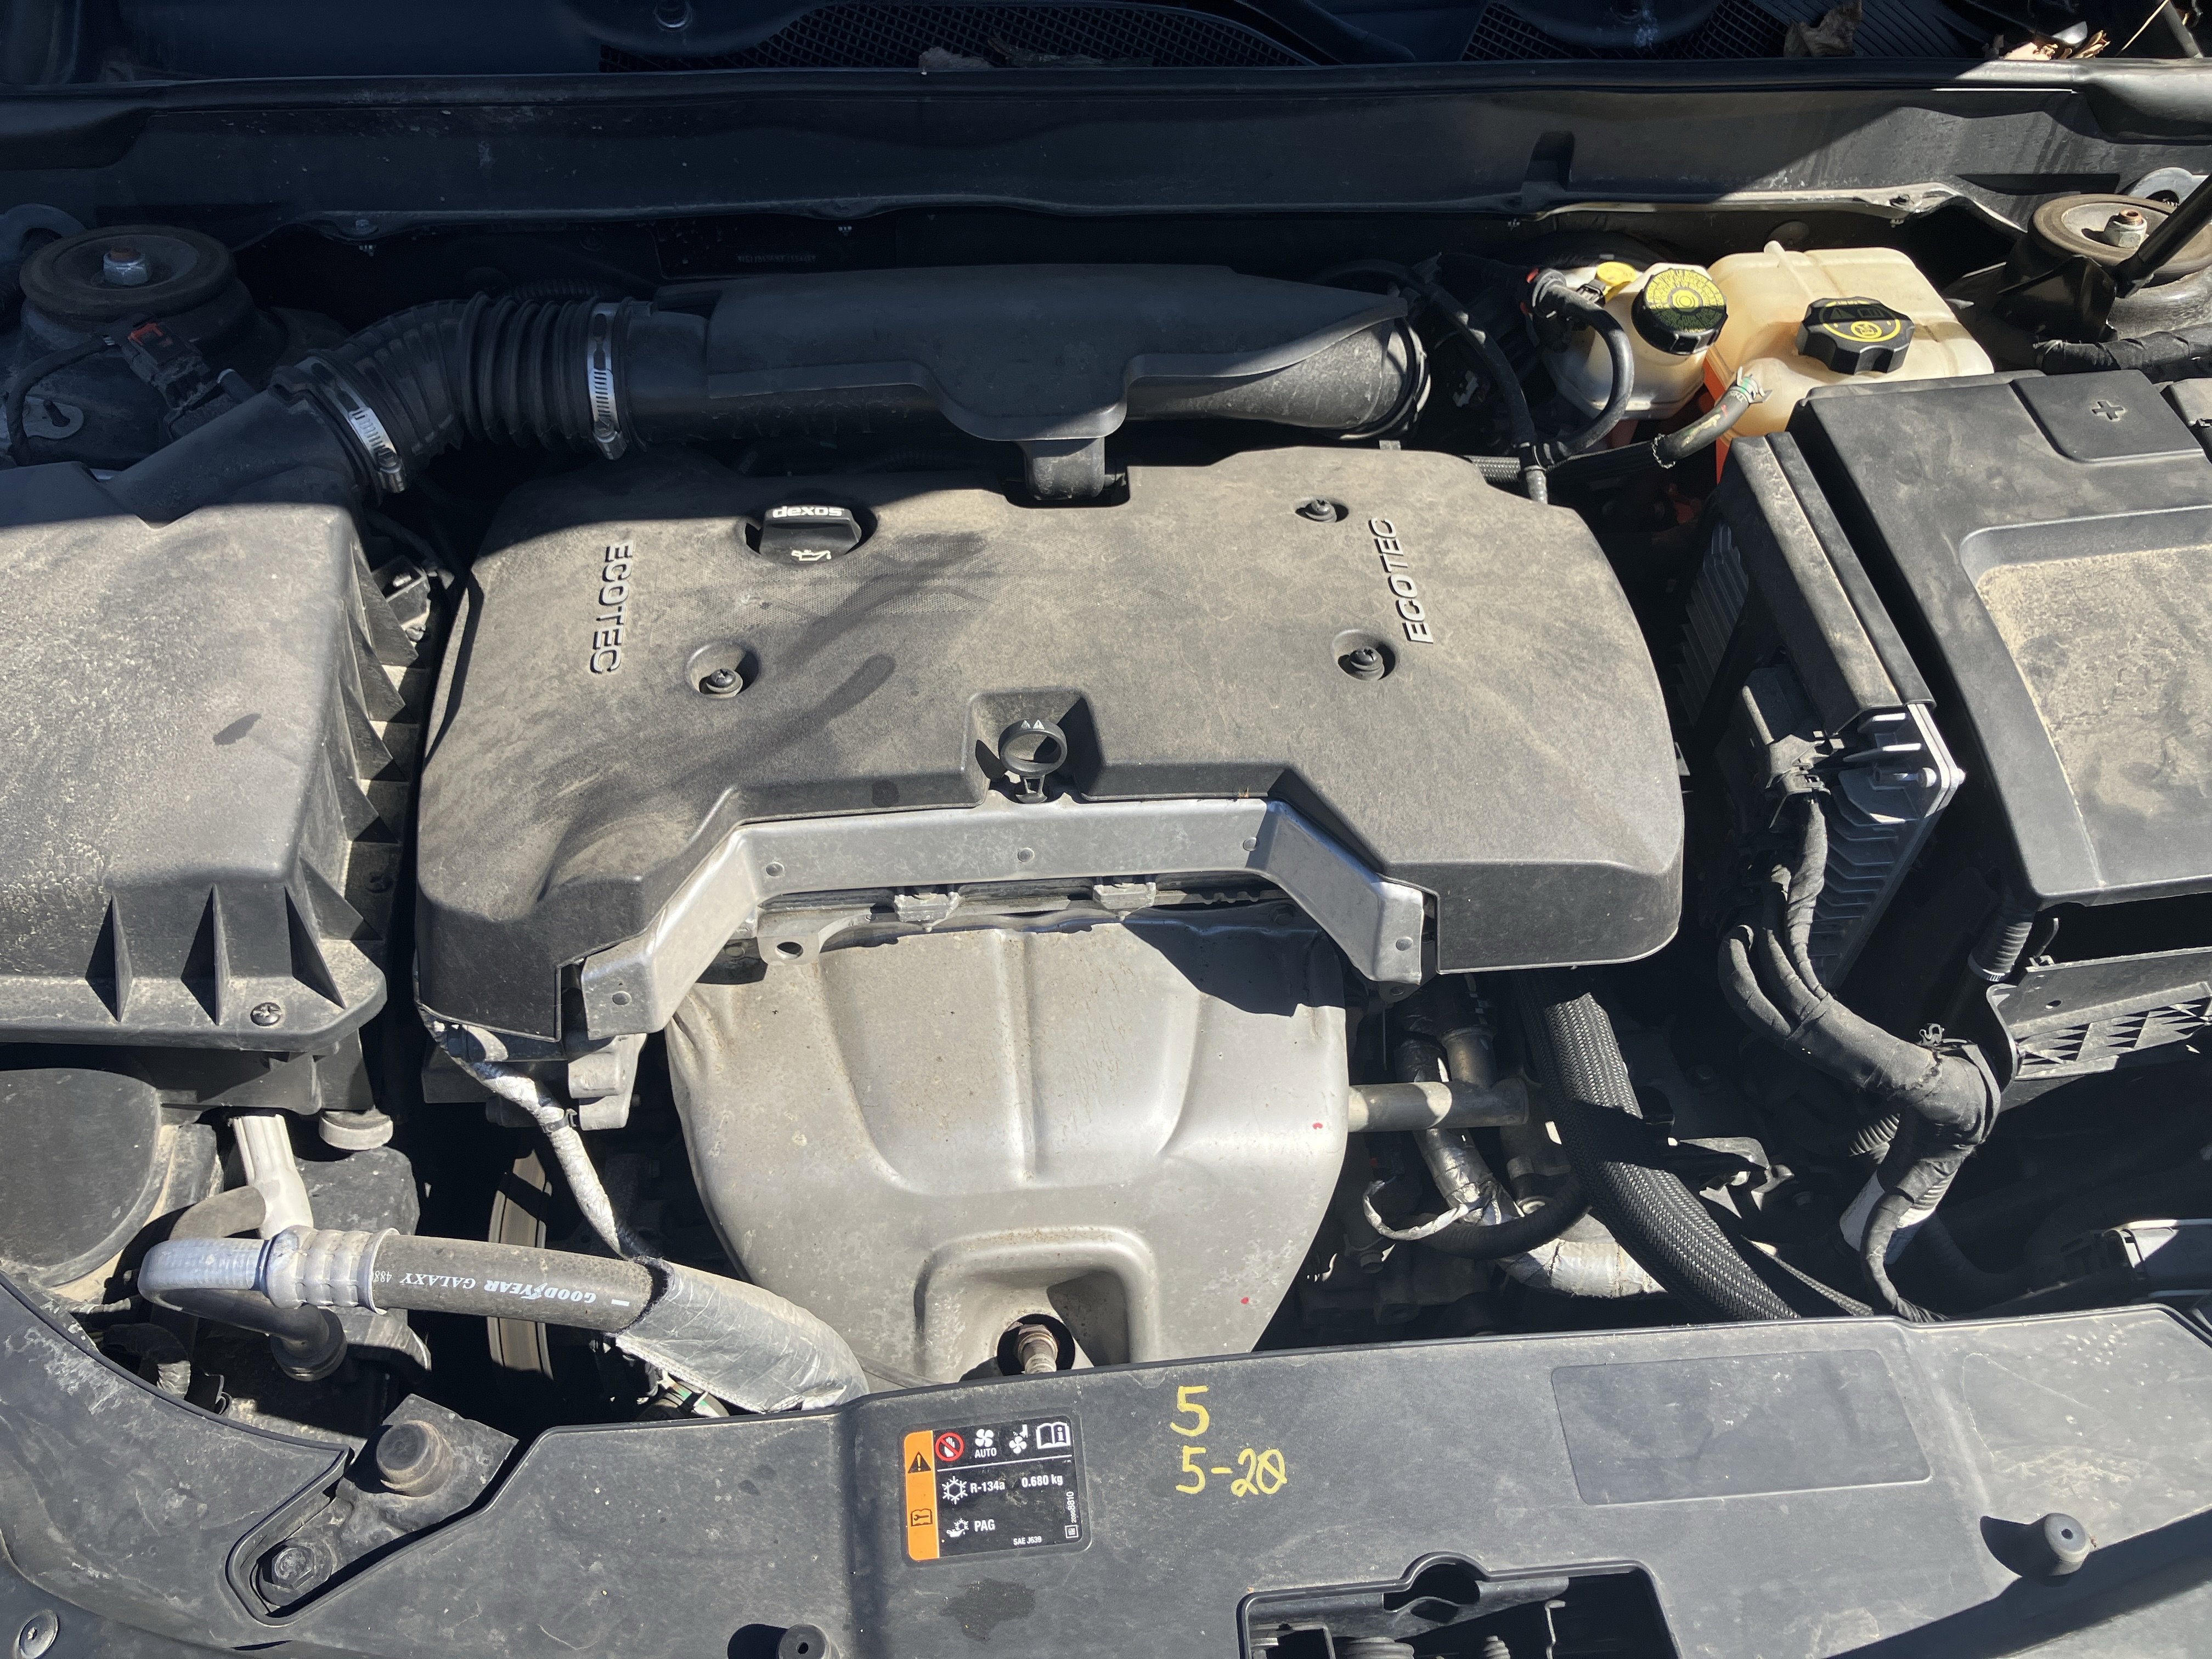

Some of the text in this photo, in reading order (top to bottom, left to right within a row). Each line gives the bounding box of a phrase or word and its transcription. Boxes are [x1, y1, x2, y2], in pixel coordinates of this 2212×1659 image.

[772, 505, 844, 518] dexos
[1369, 517, 1434, 644] ECOTEC
[589, 540, 634, 674] ECOTEC
[399, 1273, 476, 1289] GALAXY
[484, 1280, 597, 1303] GOODYEAR
[1170, 1385, 1210, 1436] 5
[974, 1447, 996, 1458] AUTO
[970, 1474, 1063, 1493] R-134a 0.680 kg
[974, 1519, 995, 1532] PAG
[1013, 1538, 1025, 1546] SAE
